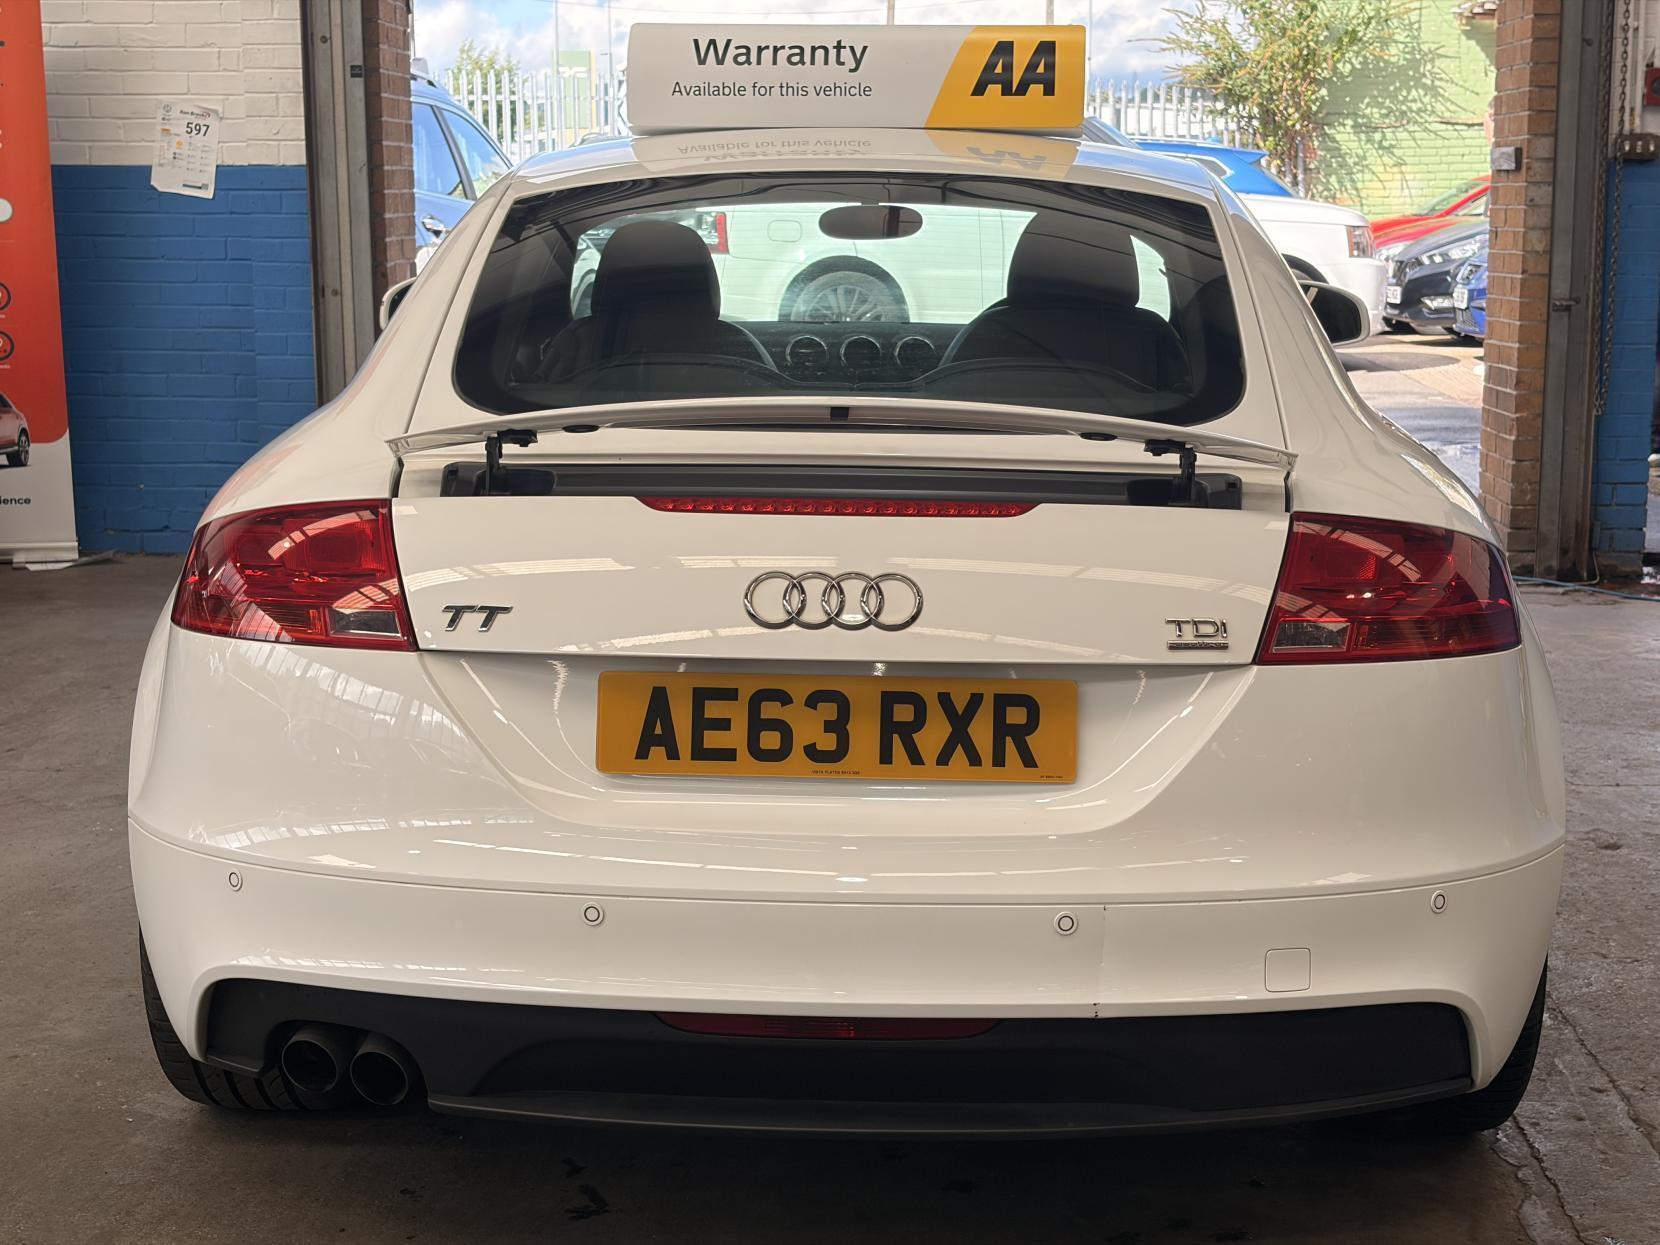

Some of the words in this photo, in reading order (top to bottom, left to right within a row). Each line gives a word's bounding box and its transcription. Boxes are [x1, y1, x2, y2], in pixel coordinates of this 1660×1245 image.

[692, 38, 868, 73] Warranty
[970, 40, 1056, 97] AA
[671, 81, 747, 97] Available
[752, 82, 775, 97] for
[779, 82, 809, 97] this
[813, 82, 873, 97] vehicle
[185, 121, 210, 137] 597
[442, 604, 514, 632] TT
[634, 686, 851, 764] AE63
[879, 690, 1041, 769] RXR
